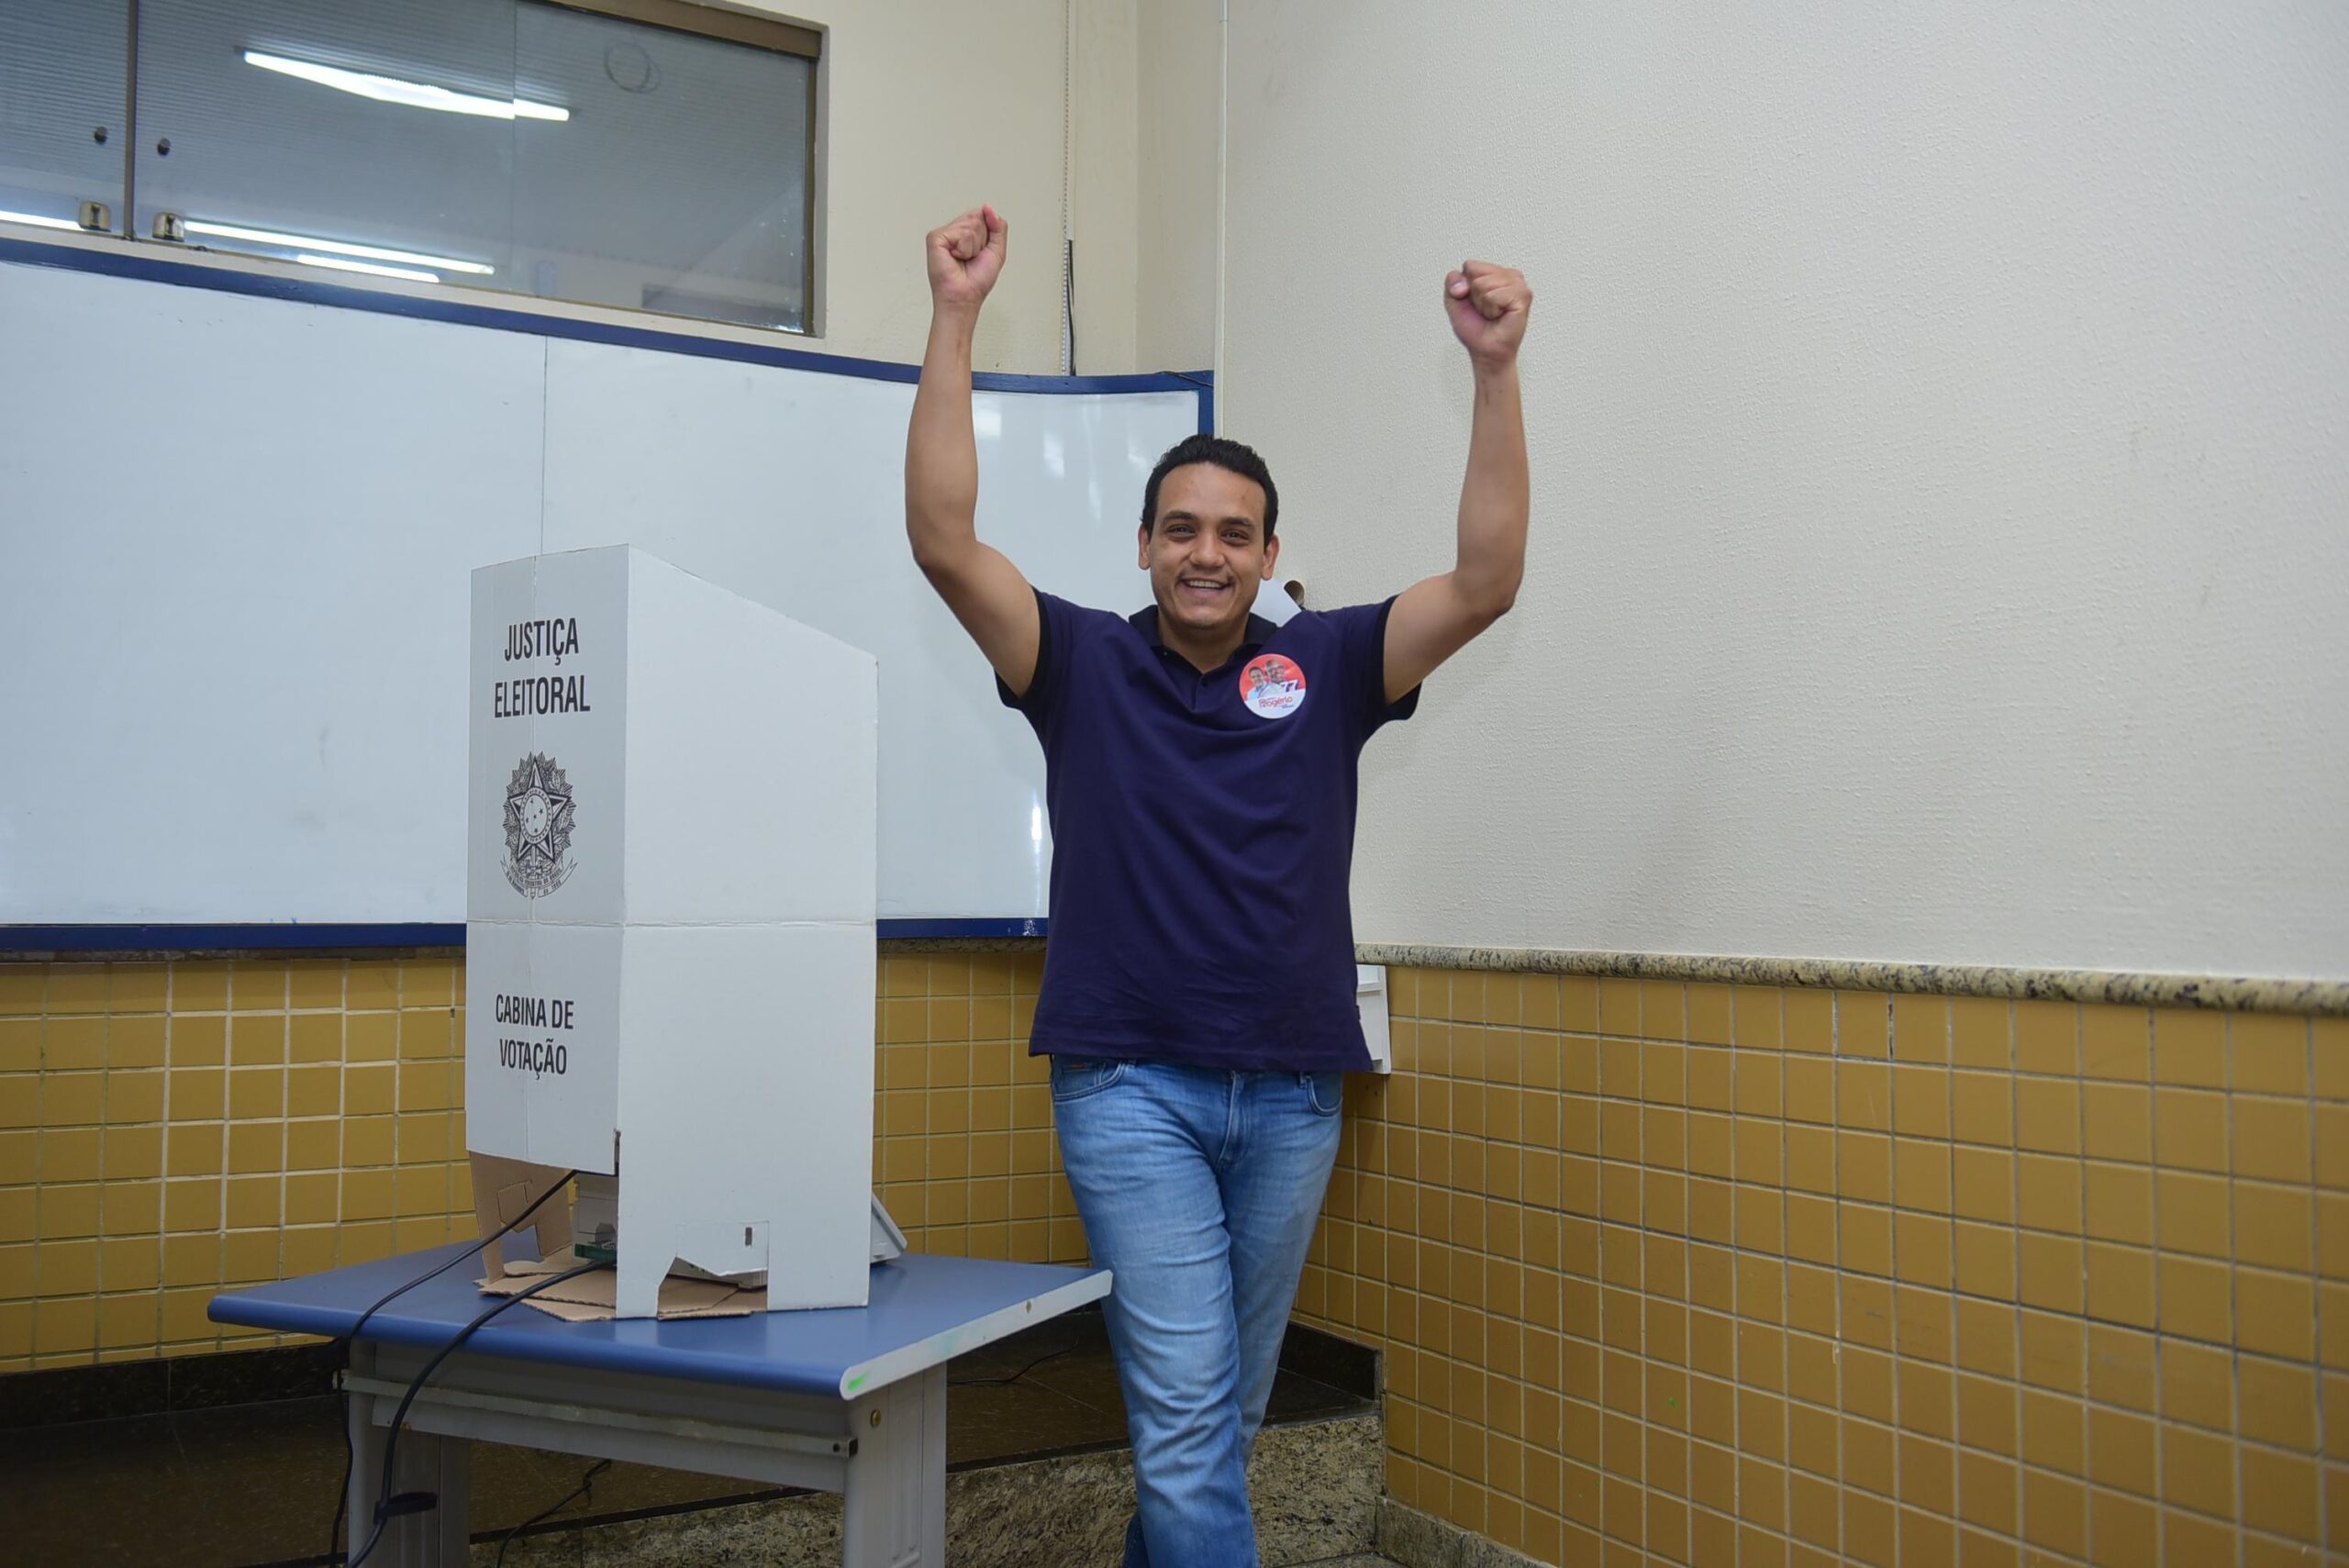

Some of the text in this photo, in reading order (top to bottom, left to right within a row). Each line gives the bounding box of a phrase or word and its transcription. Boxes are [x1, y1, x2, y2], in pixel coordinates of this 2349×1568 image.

[504, 617, 579, 666] JUSTIÇA
[494, 674, 591, 718] ELEITORAL
[495, 994, 574, 1029] CABINA DE
[499, 1038, 567, 1081] VOTAÇÃO
